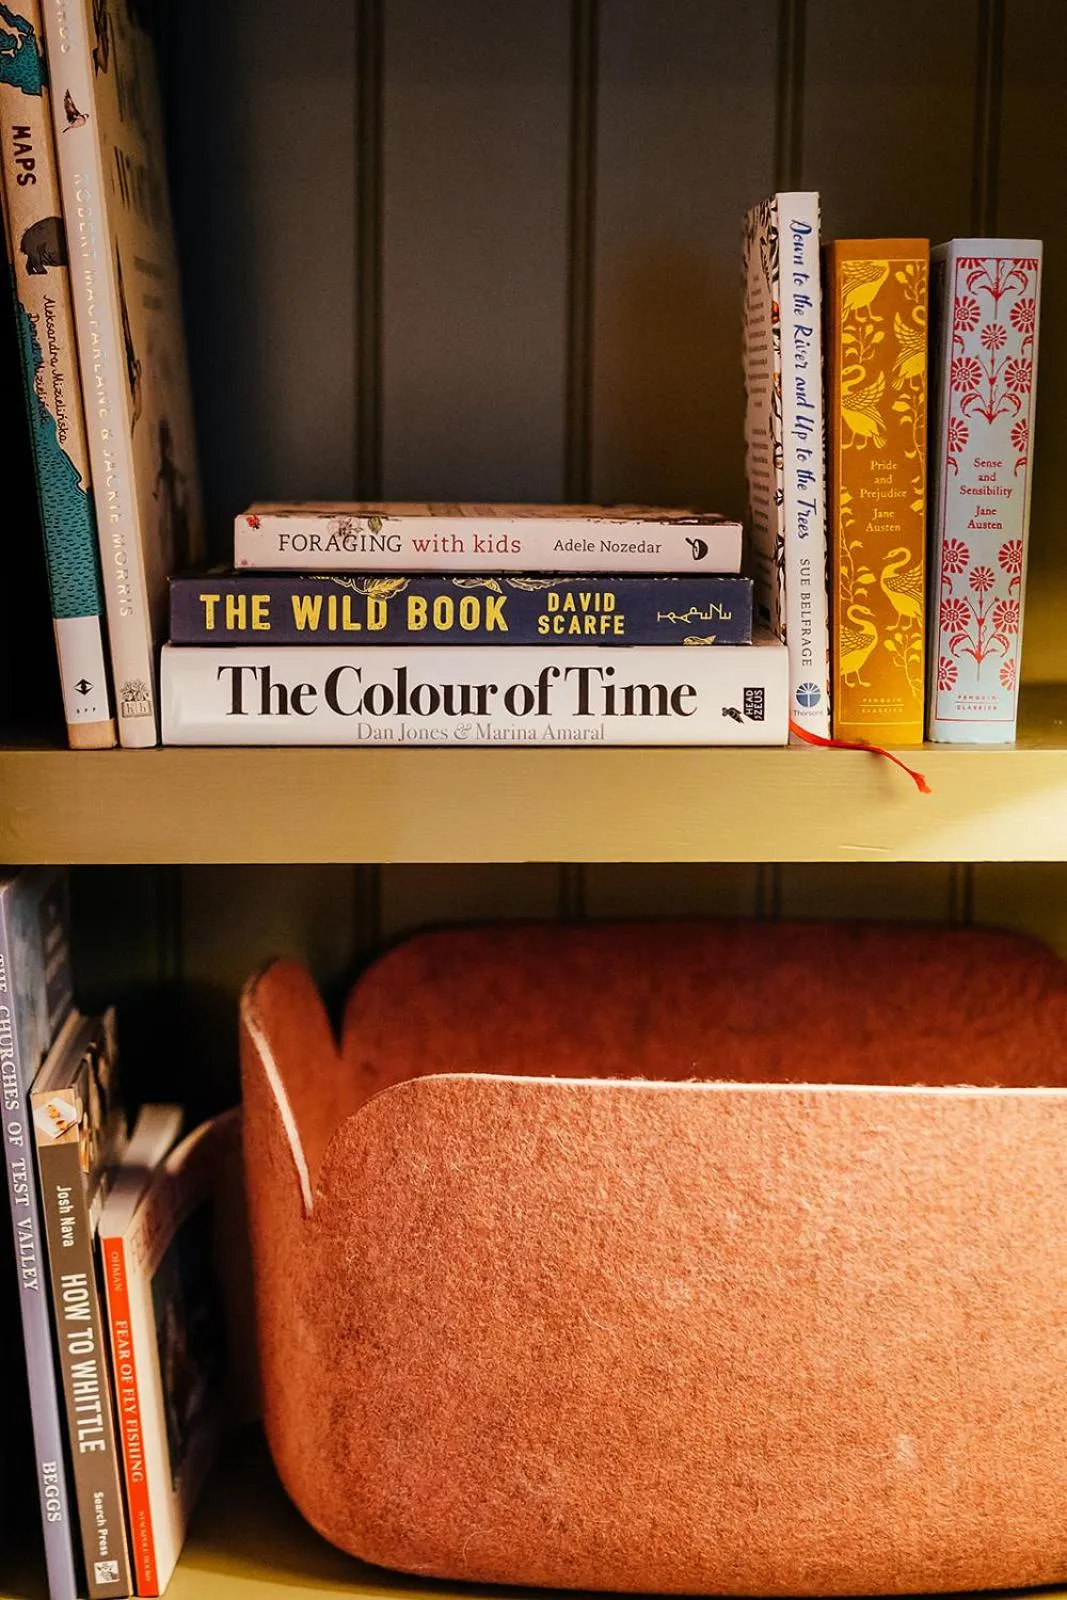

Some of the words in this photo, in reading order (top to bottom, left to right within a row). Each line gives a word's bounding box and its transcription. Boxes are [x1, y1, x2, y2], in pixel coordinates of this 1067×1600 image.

[11, 126, 37, 187] MAPS
[73, 173, 97, 260] ROBERT
[789, 219, 813, 264] Down
[793, 271, 810, 286] to
[793, 293, 813, 315] the
[27, 313, 43, 354] Daniel
[43, 295, 61, 367] Aleksandra
[793, 325, 814, 369] River
[795, 377, 815, 408] and
[101, 429, 112, 441] &
[792, 414, 815, 441] Up
[796, 447, 814, 461] to
[870, 460, 898, 471] Pride
[973, 458, 1002, 468] Sense
[103, 449, 122, 523] JACKIE
[796, 468, 816, 491] the
[874, 474, 892, 484] and
[978, 472, 996, 482] and
[860, 488, 907, 499] Prejudice
[959, 485, 1013, 498] Sensibility
[796, 498, 818, 539] Trees
[872, 508, 895, 519] Jane
[967, 519, 1002, 530] Austen
[974, 506, 997, 517] Jane
[865, 522, 901, 533] Austen
[278, 533, 402, 553] FORAGING
[411, 534, 465, 553] with
[472, 534, 521, 554] kids
[553, 539, 595, 552] Adele
[599, 539, 662, 554] Nozedar
[112, 534, 133, 616] MORRIS
[800, 559, 811, 586] SUE
[199, 594, 272, 631] THE
[291, 595, 388, 631] WILD
[407, 595, 509, 632] BOOK
[547, 592, 616, 612] DAVID
[537, 614, 625, 636] SCARFE
[800, 592, 813, 667] BELFRAGE
[217, 665, 318, 716] The
[324, 665, 498, 716] Colour
[503, 665, 561, 717] of
[564, 666, 699, 717] Time
[746, 690, 754, 716] HEAD
[357, 723, 394, 740] Dan
[397, 723, 448, 742] Jones
[453, 724, 473, 740] &
[475, 723, 537, 740] Marina
[542, 723, 605, 740] Amaral
[0, 1005, 20, 1111] CHURCHES
[6, 1122, 24, 1147] OF
[11, 1157, 30, 1206] TEST
[56, 1185, 72, 1213] Josh
[59, 1214, 76, 1247] Nava
[15, 1216, 39, 1292] VALLEY
[111, 1251, 122, 1293] OHMAN
[60, 1273, 92, 1321] HOW
[67, 1327, 95, 1354] TO
[115, 1319, 130, 1360] FEAR
[119, 1362, 133, 1383] OF
[71, 1359, 106, 1453] WHITTLE
[122, 1387, 138, 1416] FLY
[128, 1418, 145, 1483] FISHING
[40, 1461, 62, 1523] BEGGS
[93, 1491, 107, 1527] Search
[97, 1528, 109, 1556] Press
